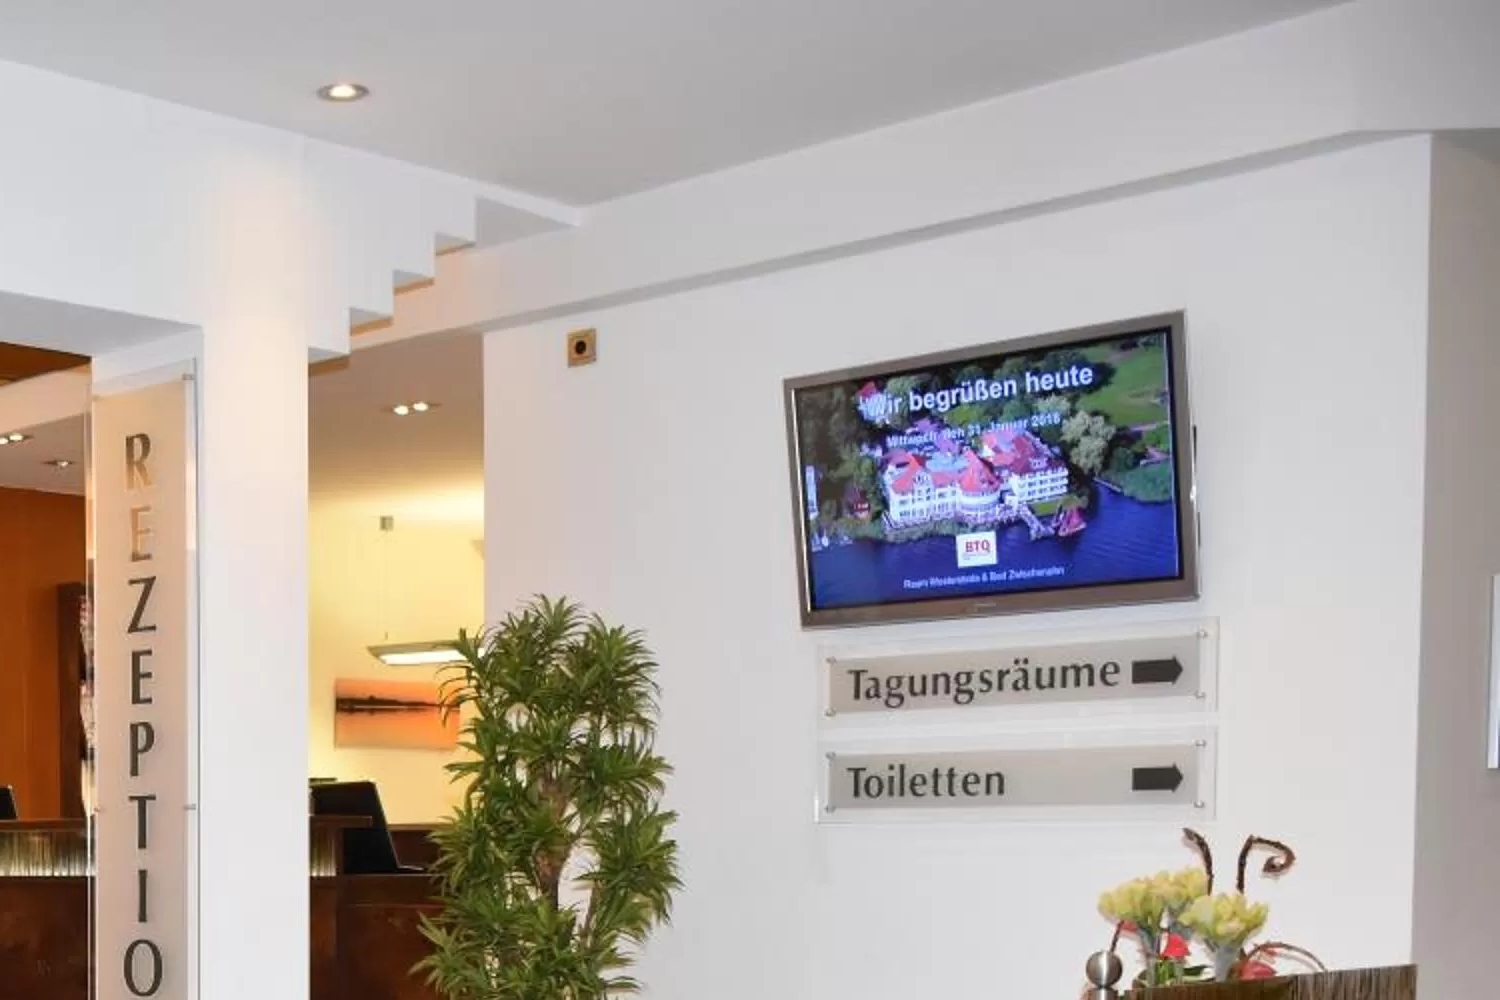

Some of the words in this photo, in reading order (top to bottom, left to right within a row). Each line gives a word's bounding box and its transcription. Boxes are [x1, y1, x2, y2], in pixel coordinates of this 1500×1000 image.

[909, 378, 1017, 413] begrüßen
[1025, 366, 1093, 393] heute
[964, 539, 991, 553] BTQ
[847, 656, 1120, 708] Tagungsräume
[846, 763, 1005, 799] Toiletten
